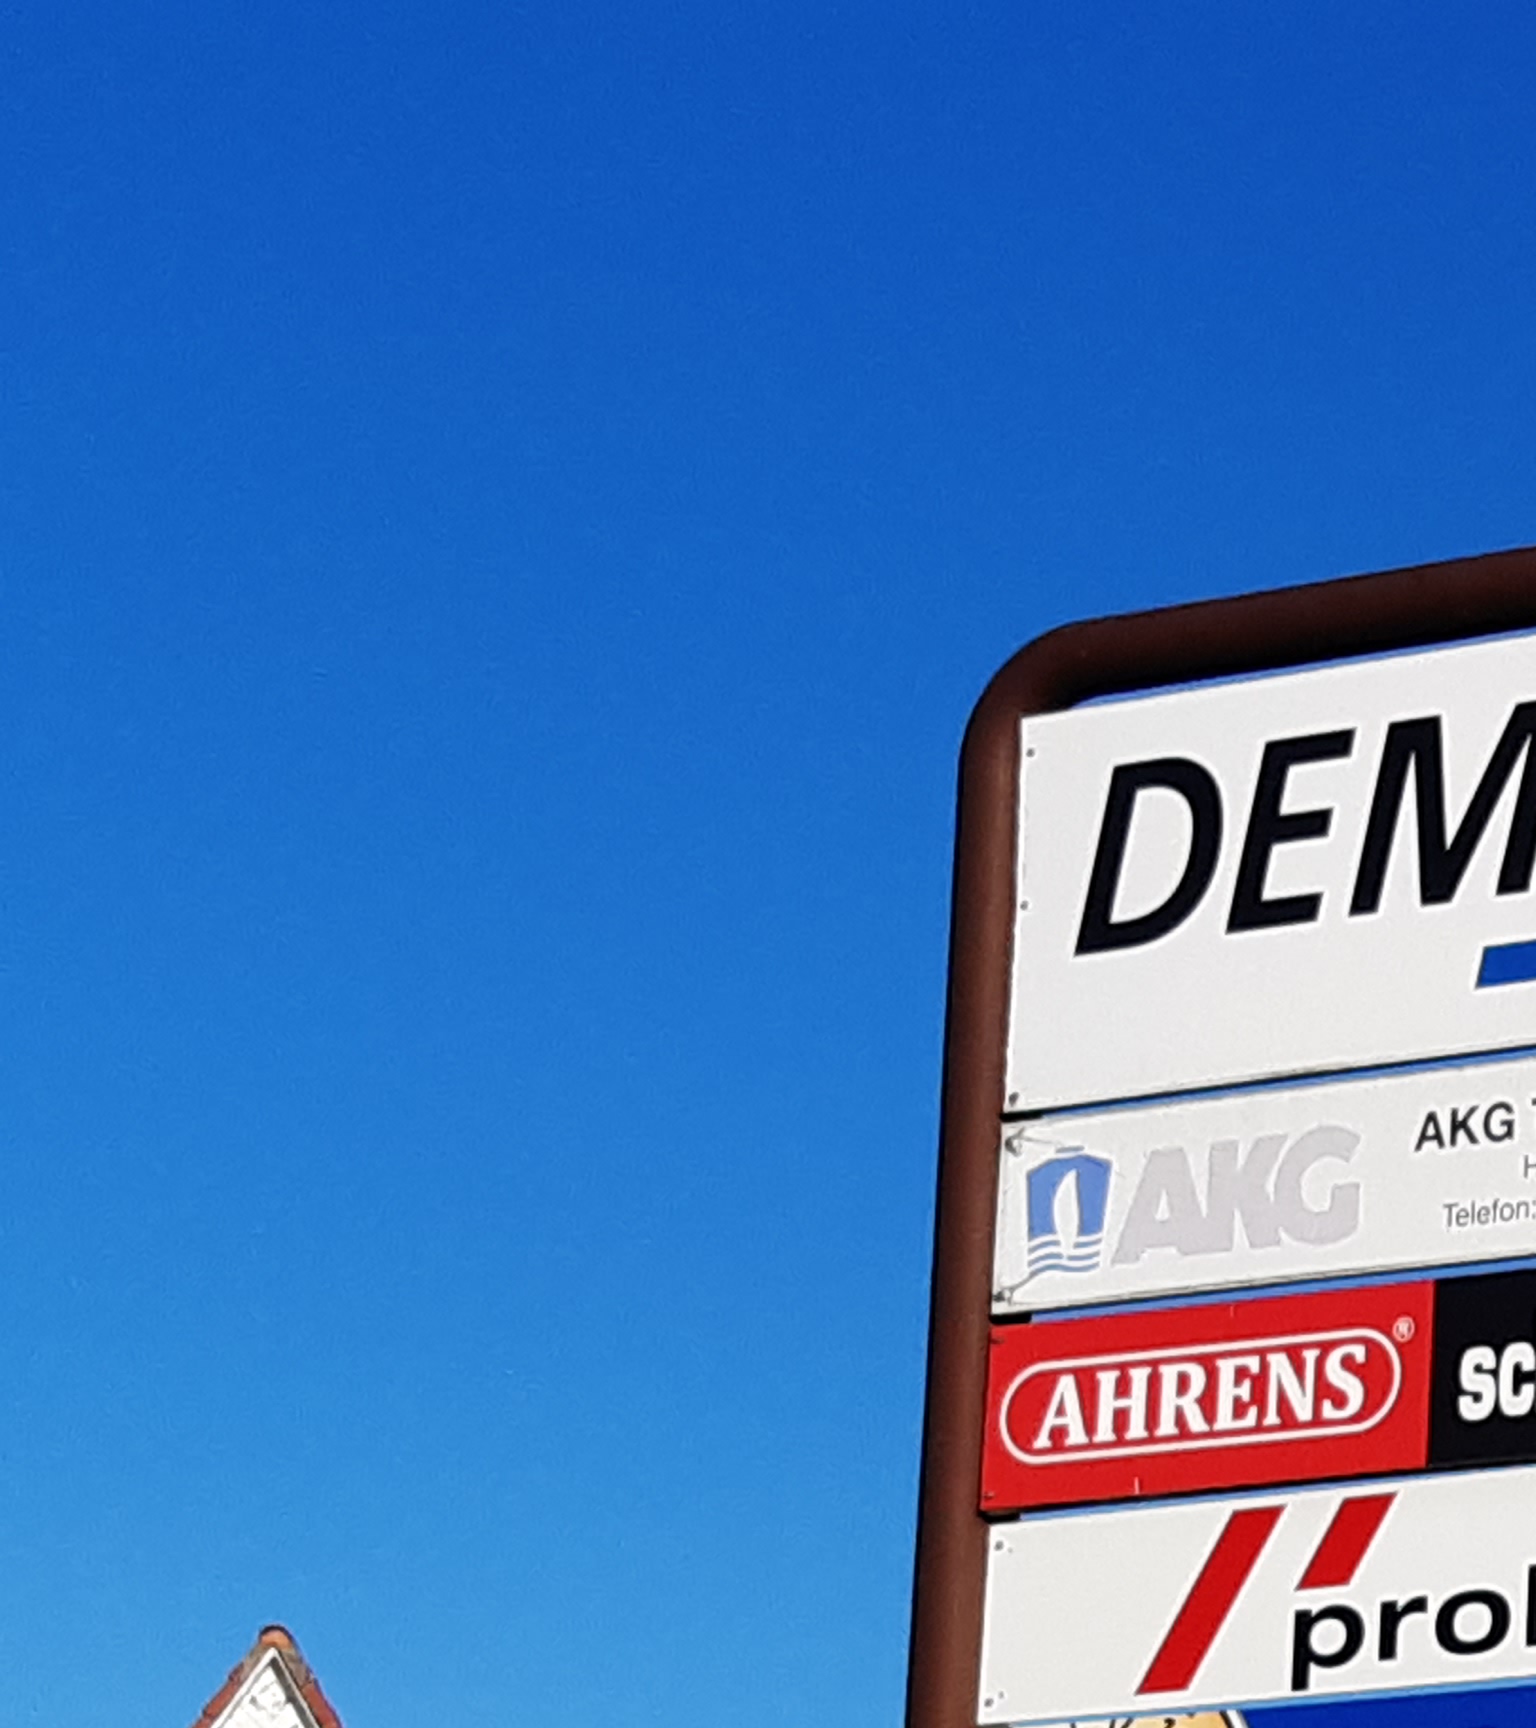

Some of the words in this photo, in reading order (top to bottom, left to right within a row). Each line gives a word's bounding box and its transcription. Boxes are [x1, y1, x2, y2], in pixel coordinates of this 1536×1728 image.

[1414, 1102, 1516, 1151] AKG
[1112, 1125, 1360, 1265] AKG
[1443, 1195, 1536, 1231] Telefon:
[1033, 1343, 1366, 1450] AHRENS
